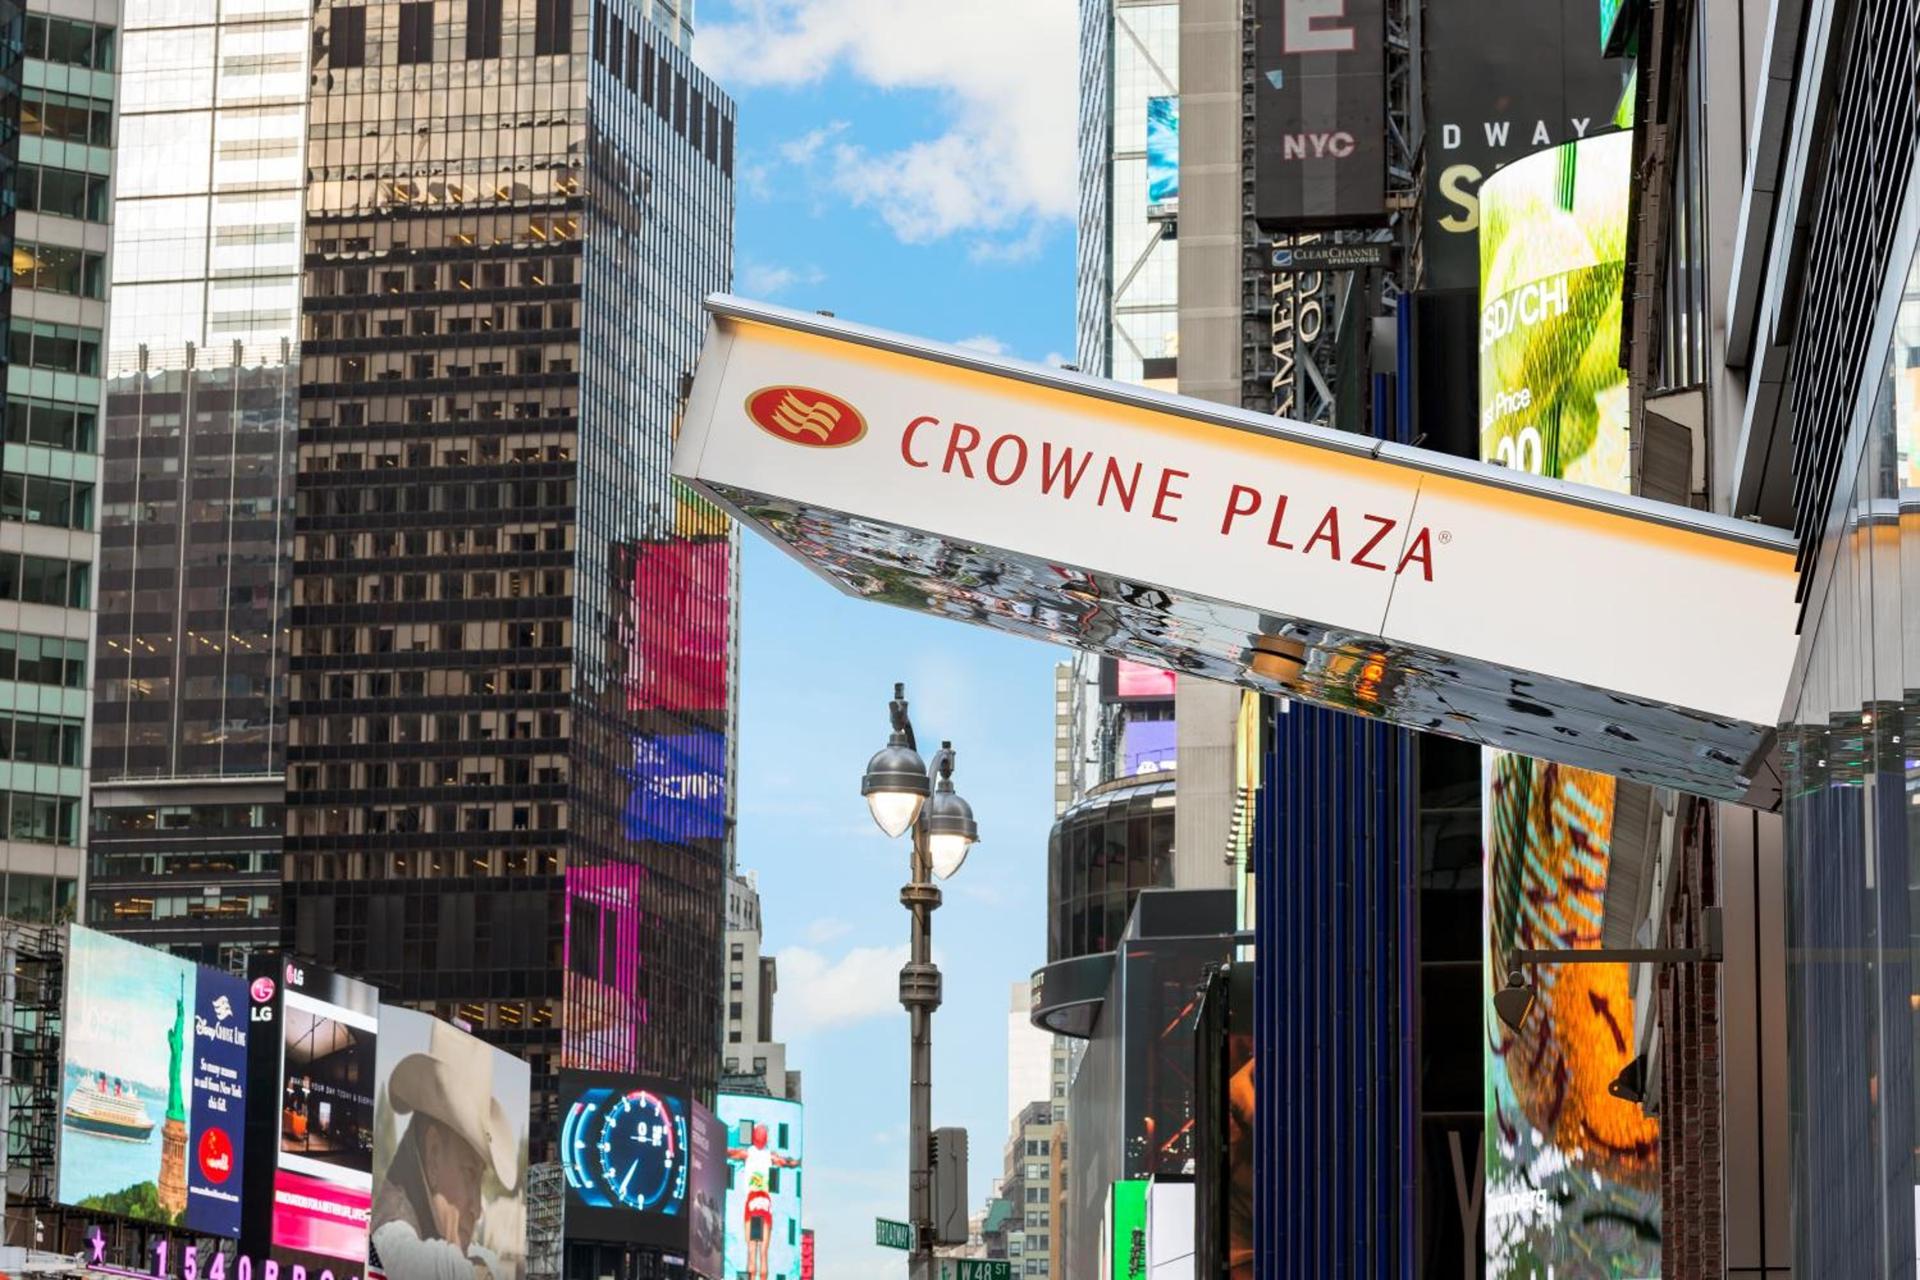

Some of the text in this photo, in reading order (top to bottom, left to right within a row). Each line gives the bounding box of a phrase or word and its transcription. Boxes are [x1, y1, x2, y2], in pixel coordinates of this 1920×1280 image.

[1283, 131, 1355, 160] NYC
[1495, 387, 1531, 420] Price
[900, 415, 1189, 523] CROWNE
[195, 1014, 216, 1041] Disney
[251, 1005, 273, 1022] LG
[877, 1220, 909, 1249] BROADWAY
[961, 1262, 1008, 1280] W 48 ST
